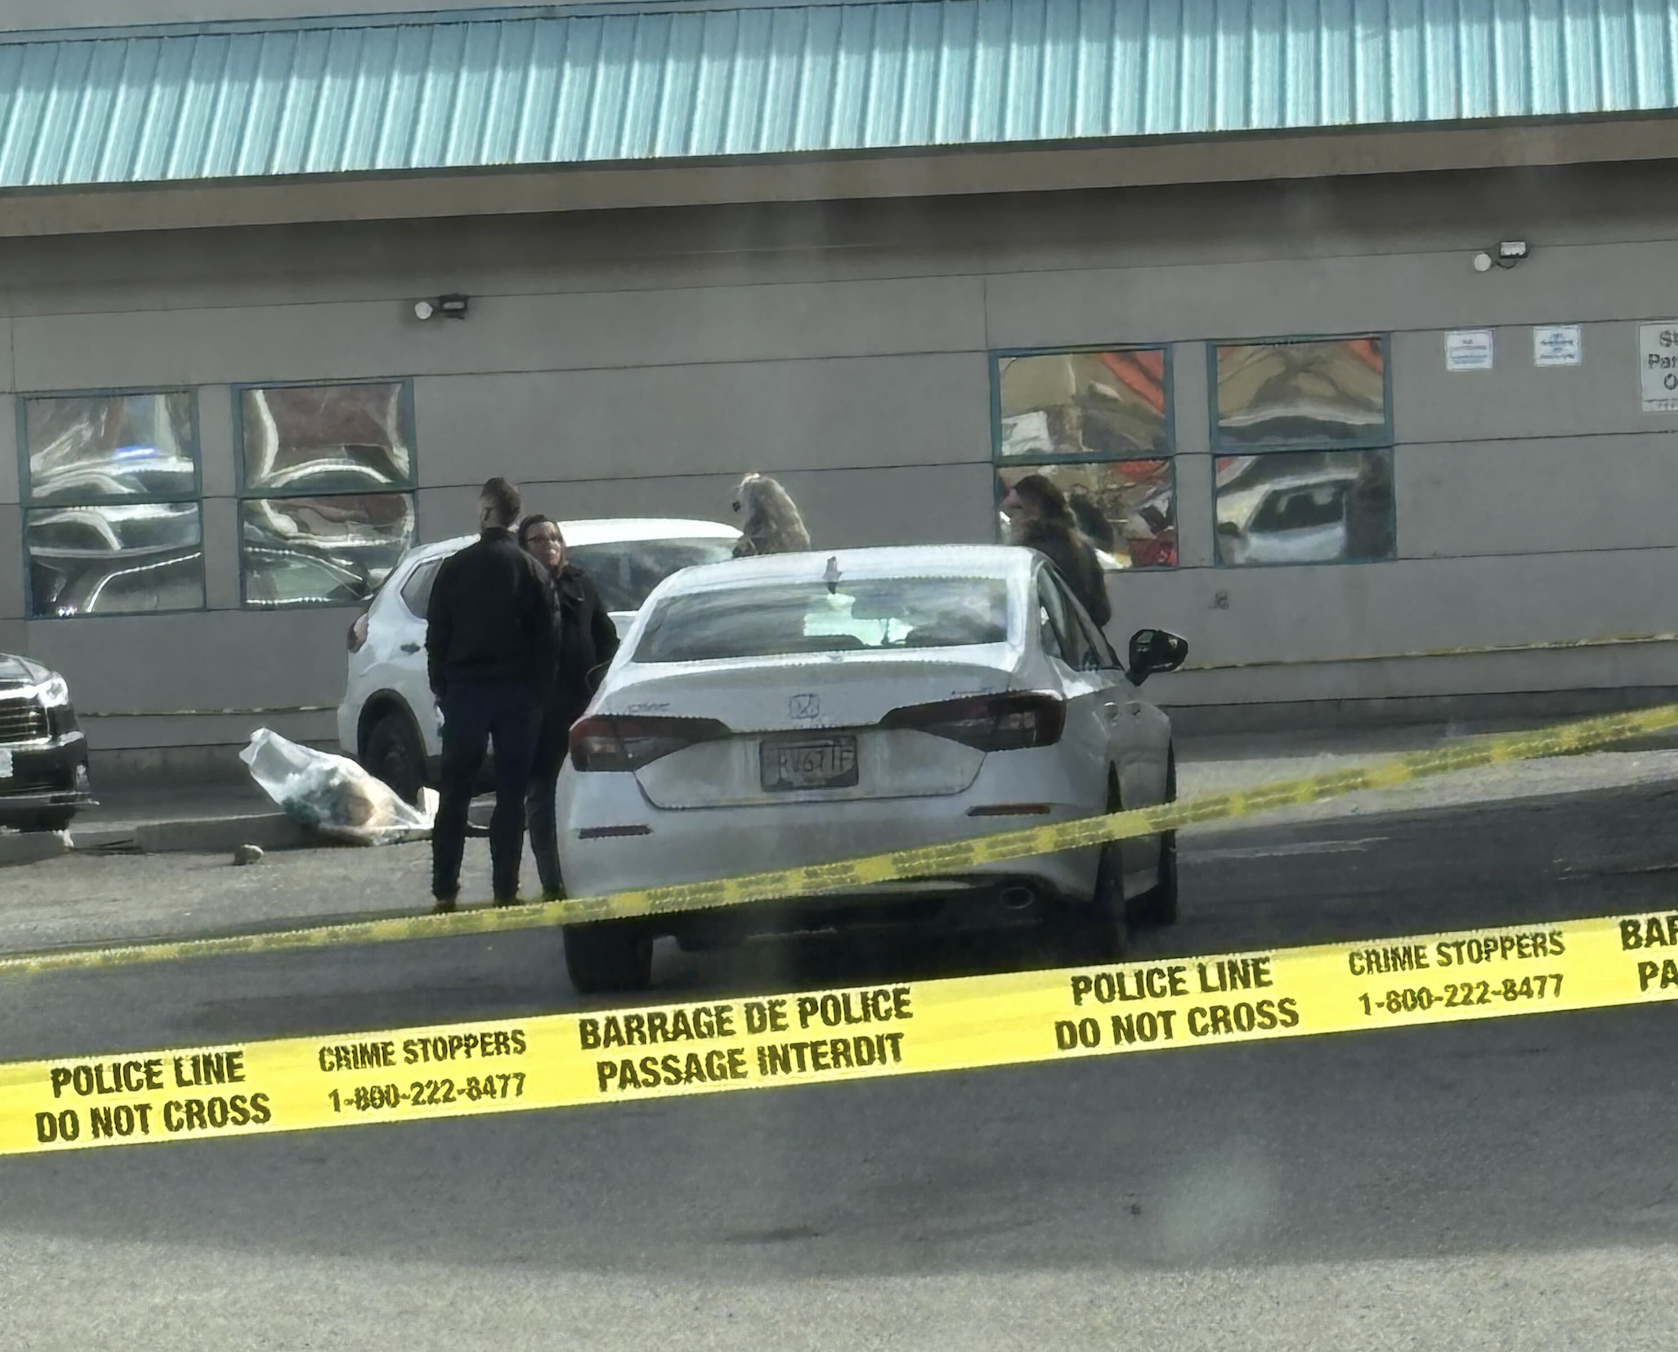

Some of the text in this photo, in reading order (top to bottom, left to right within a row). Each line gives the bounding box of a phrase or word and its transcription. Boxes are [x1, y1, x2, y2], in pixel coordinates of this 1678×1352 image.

[1349, 931, 1566, 976] CRIME STOPPERS
[1638, 959, 1678, 992] PA
[1071, 957, 1273, 1006] POLICE LINE
[1358, 974, 1563, 1015] 1-800-222-8477
[579, 987, 914, 1050] BARRAGE DE POLICE
[1055, 997, 1299, 1050] DO NOT CROSS
[319, 1029, 527, 1072] CRIME STOPPERS
[597, 1033, 904, 1092] PASSAGE INTERDIT
[51, 1051, 246, 1098] POLICE LINE
[328, 1072, 527, 1113] 1-800-222-8477
[35, 1093, 272, 1142] DO NOT CROSS
